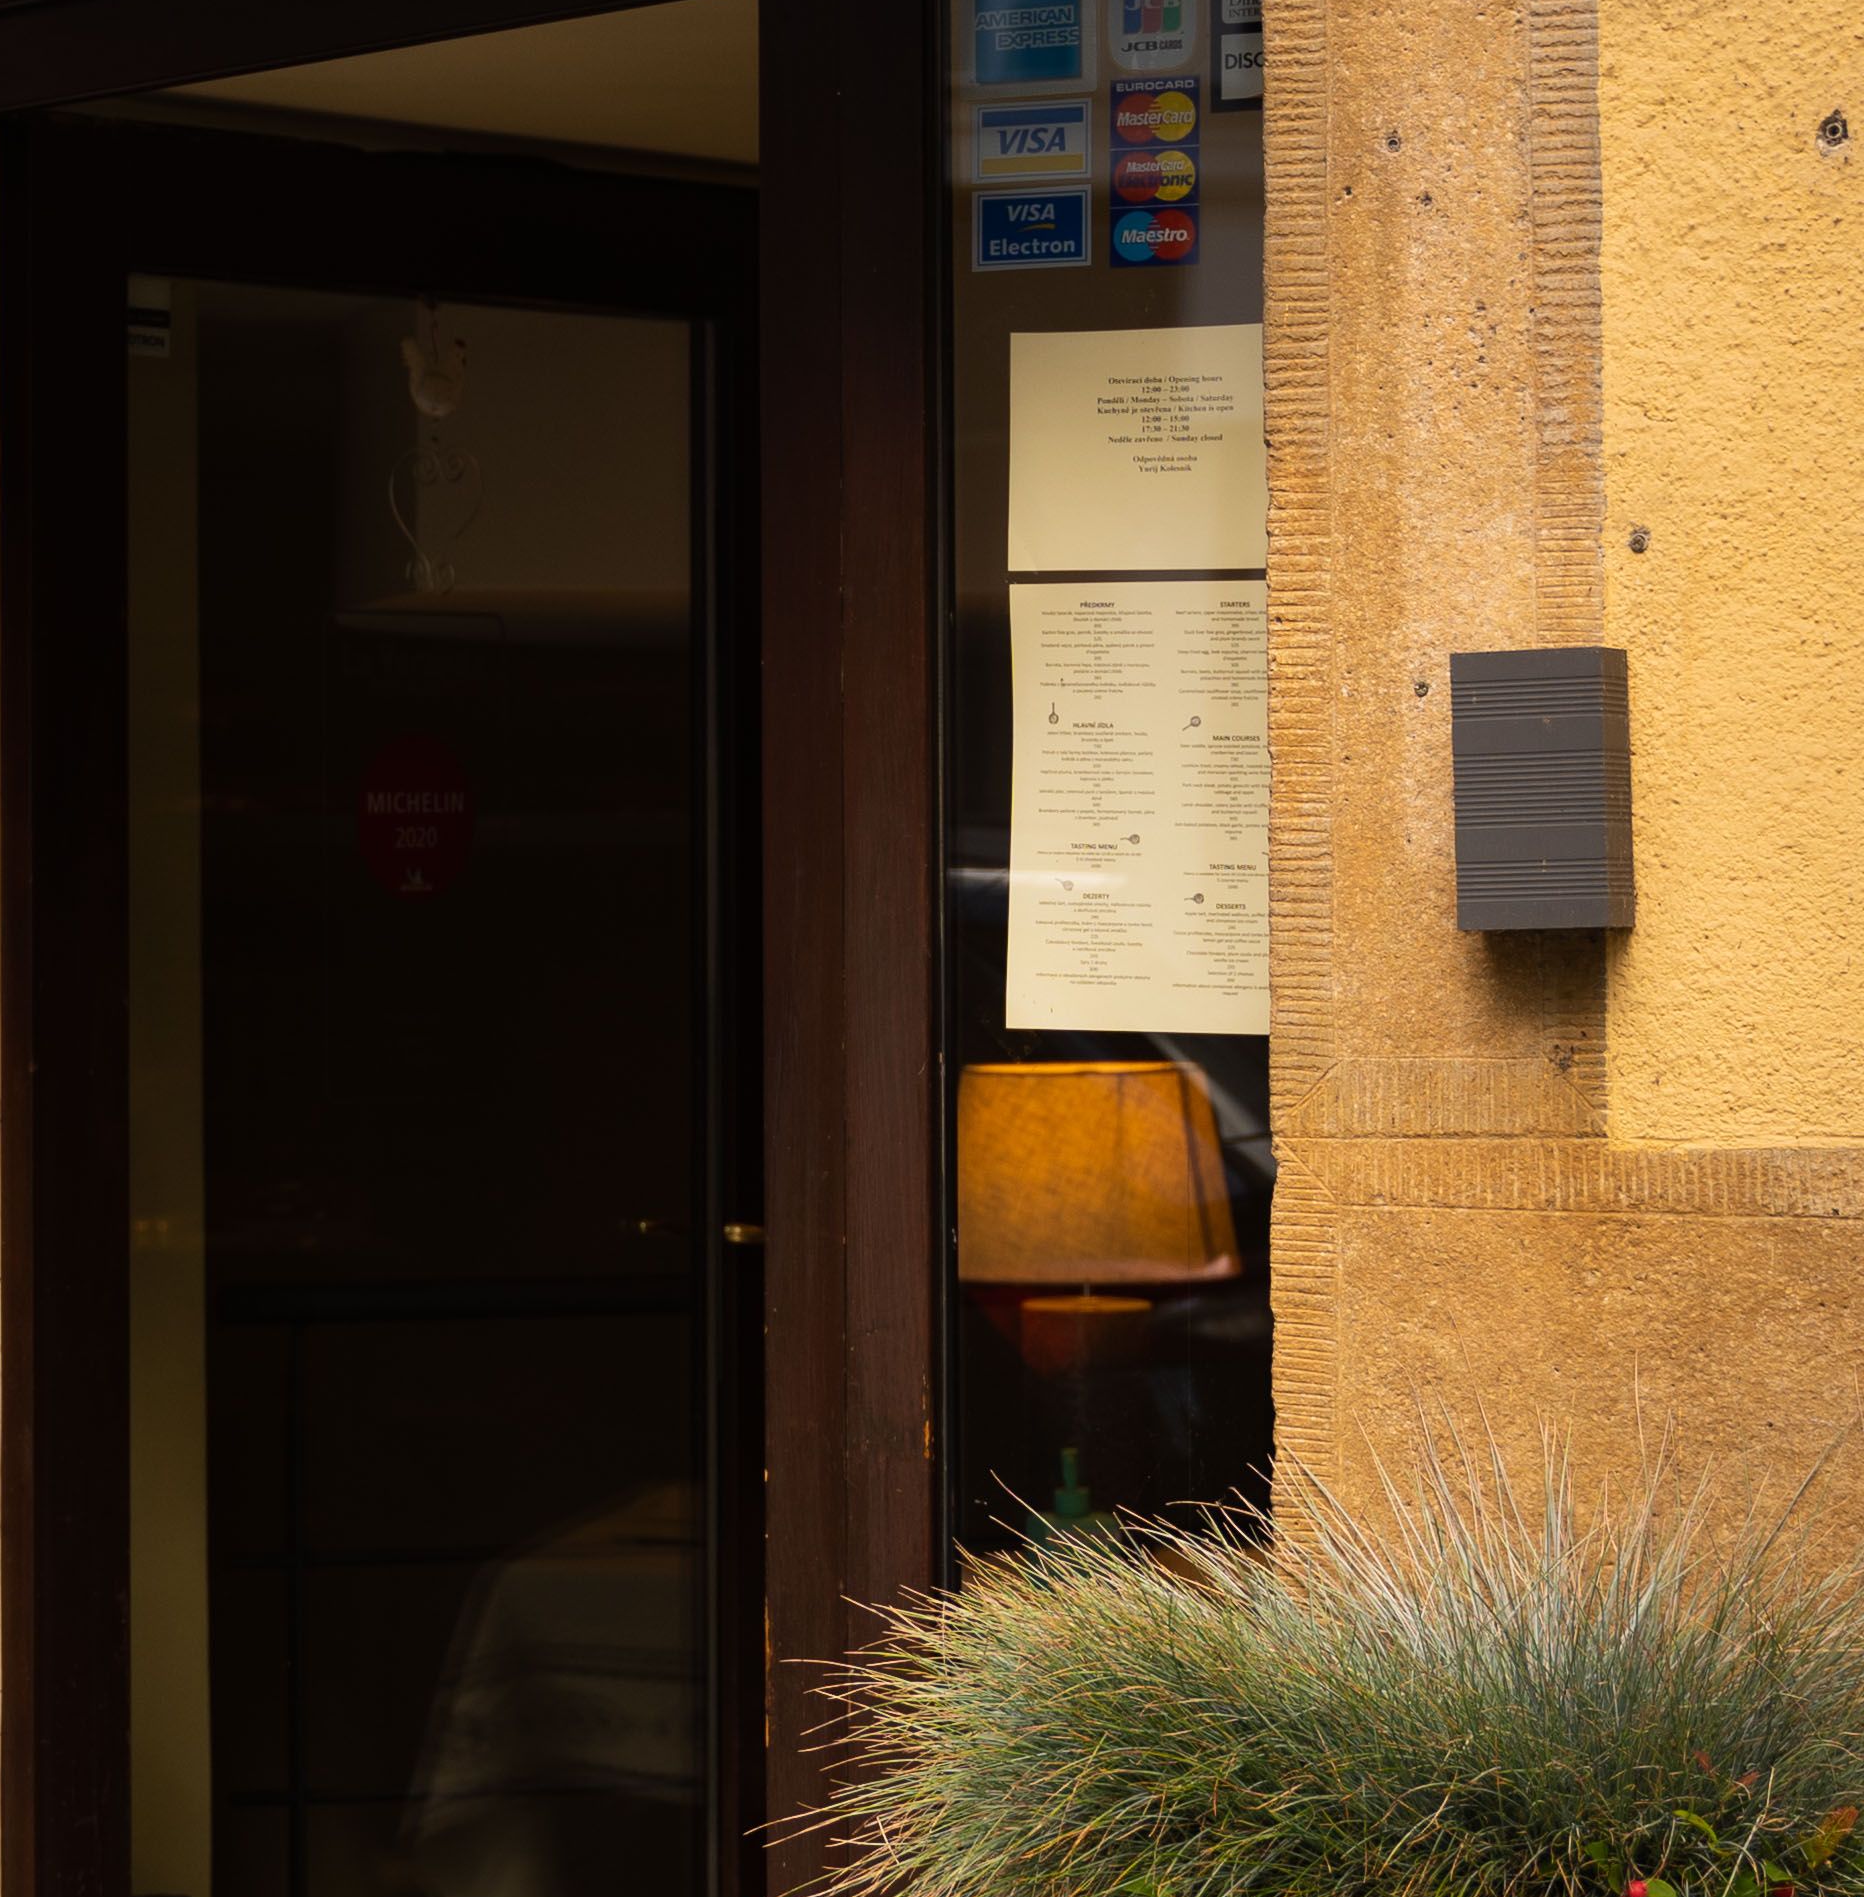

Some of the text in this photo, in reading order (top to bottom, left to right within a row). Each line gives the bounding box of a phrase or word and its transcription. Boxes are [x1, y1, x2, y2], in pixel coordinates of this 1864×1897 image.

[975, 6, 1074, 29] AMERICAN
[996, 26, 1080, 51] EXPRESS
[1120, 38, 1183, 53] JCB CARDS
[1116, 79, 1194, 92] EUROCARD
[1116, 108, 1193, 127] MasterCard
[997, 128, 1066, 156] VISA
[1126, 159, 1184, 173] MasterCard
[1118, 171, 1192, 189] Electronic
[1007, 204, 1055, 222] VISA
[1120, 226, 1188, 244] Maestro
[989, 238, 1076, 257] Electron
[1168, 376, 1200, 384] Opening
[1200, 394, 1233, 402] Saturday
